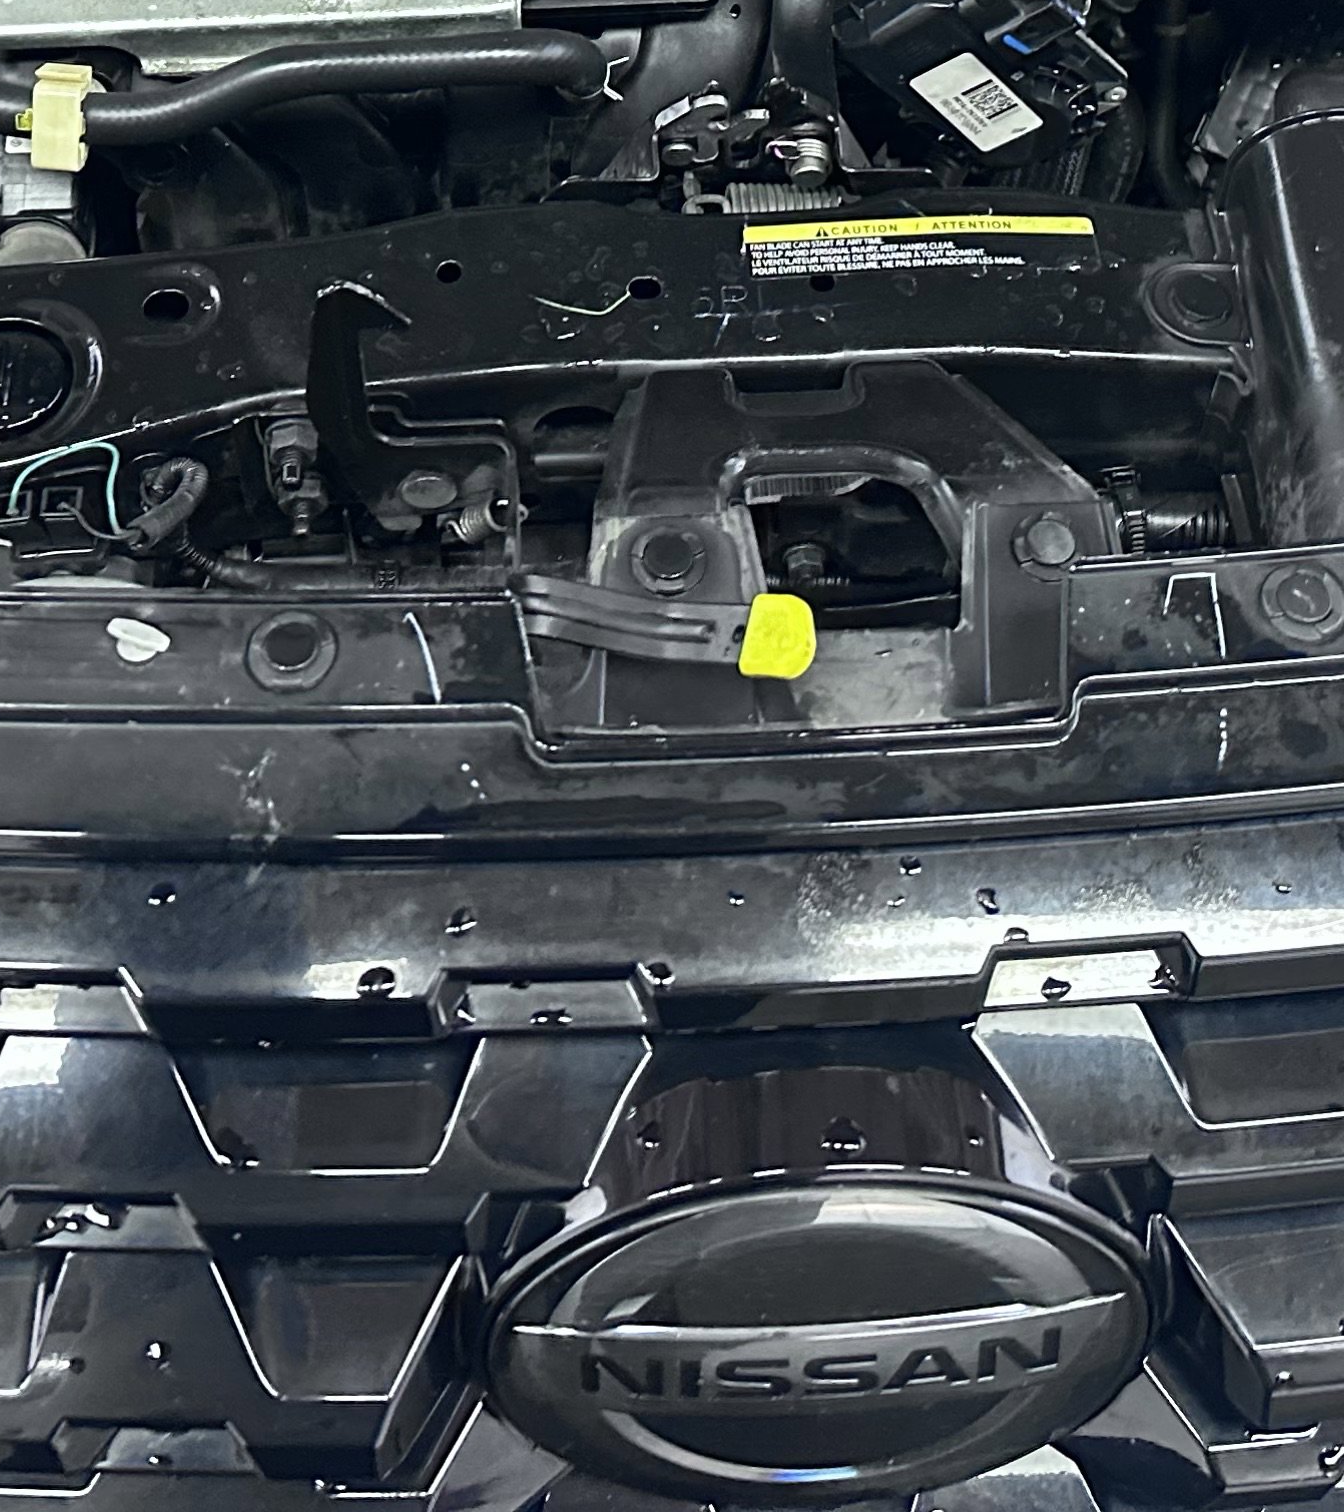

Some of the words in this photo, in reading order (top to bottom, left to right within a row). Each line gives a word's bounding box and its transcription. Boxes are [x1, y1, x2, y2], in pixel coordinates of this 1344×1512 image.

[831, 224, 898, 235] CAUTION
[932, 221, 1012, 231] ATTENTION
[749, 243, 766, 251] FAN
[767, 242, 792, 250] BLADE
[792, 241, 810, 249] CAN
[811, 239, 834, 248] START
[846, 238, 863, 246] ANY
[751, 251, 763, 259] TO
[763, 250, 784, 259] HELP
[784, 249, 809, 258] AVOID
[809, 248, 850, 257] PERSONAL
[880, 244, 899, 252] KEEP
[928, 241, 956, 249] CLEAR.
[751, 260, 762, 268] LE
[762, 257, 819, 267] VENTILATEUR
[819, 254, 851, 263] RISQUE
[851, 253, 864, 261] DE
[921, 249, 944, 257] TOUT
[945, 248, 987, 257] MOMENT.
[752, 268, 777, 276] POUR
[808, 264, 836, 272] TOUTE
[882, 260, 895, 268] NE
[926, 257, 977, 266] APPROCHER
[978, 256, 994, 264] LES
[994, 256, 1026, 265] MAINS.
[581, 1325, 1062, 1402] NISSAN
